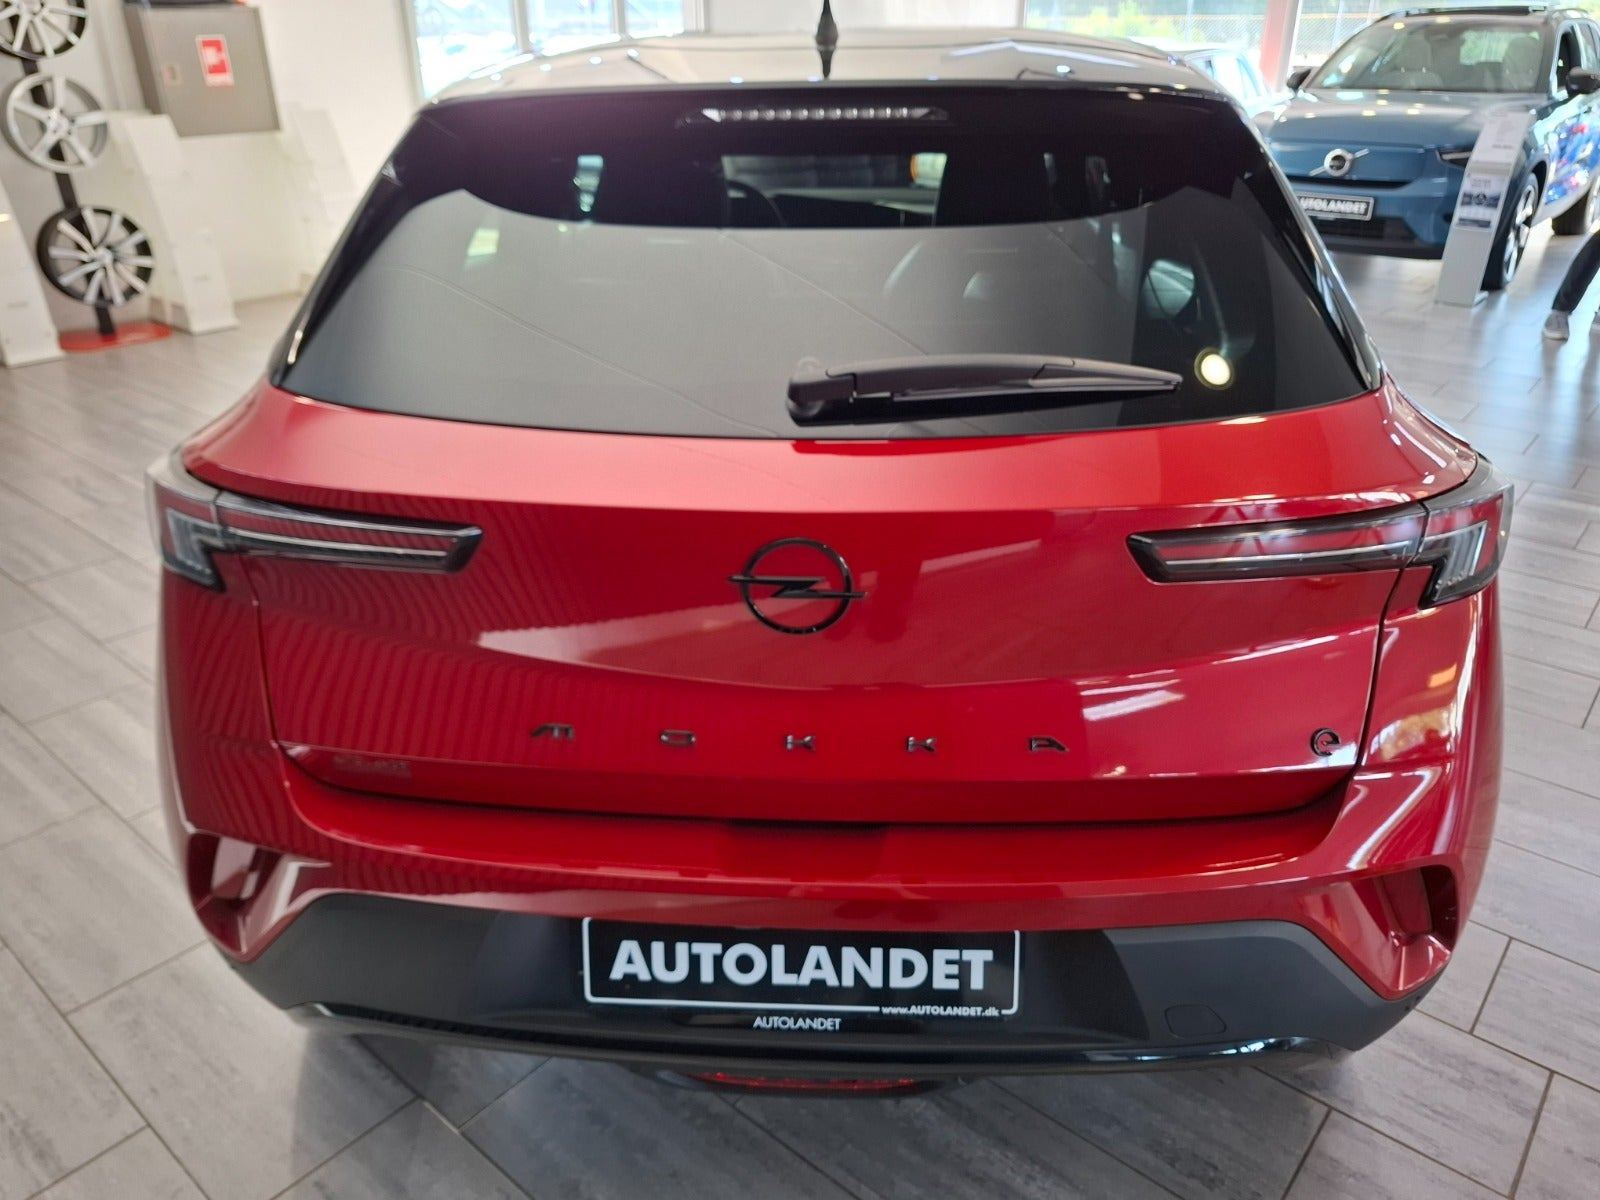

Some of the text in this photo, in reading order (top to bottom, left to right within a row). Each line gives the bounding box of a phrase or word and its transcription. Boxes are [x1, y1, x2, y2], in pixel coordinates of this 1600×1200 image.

[1300, 197, 1368, 214] UTOLANDET
[530, 722, 1069, 753] MOKKA
[608, 938, 994, 991] AUTOLANDET
[881, 1004, 1000, 1017] www.AUTOLANDET.dk
[752, 1015, 843, 1031] AUTOLANDET
